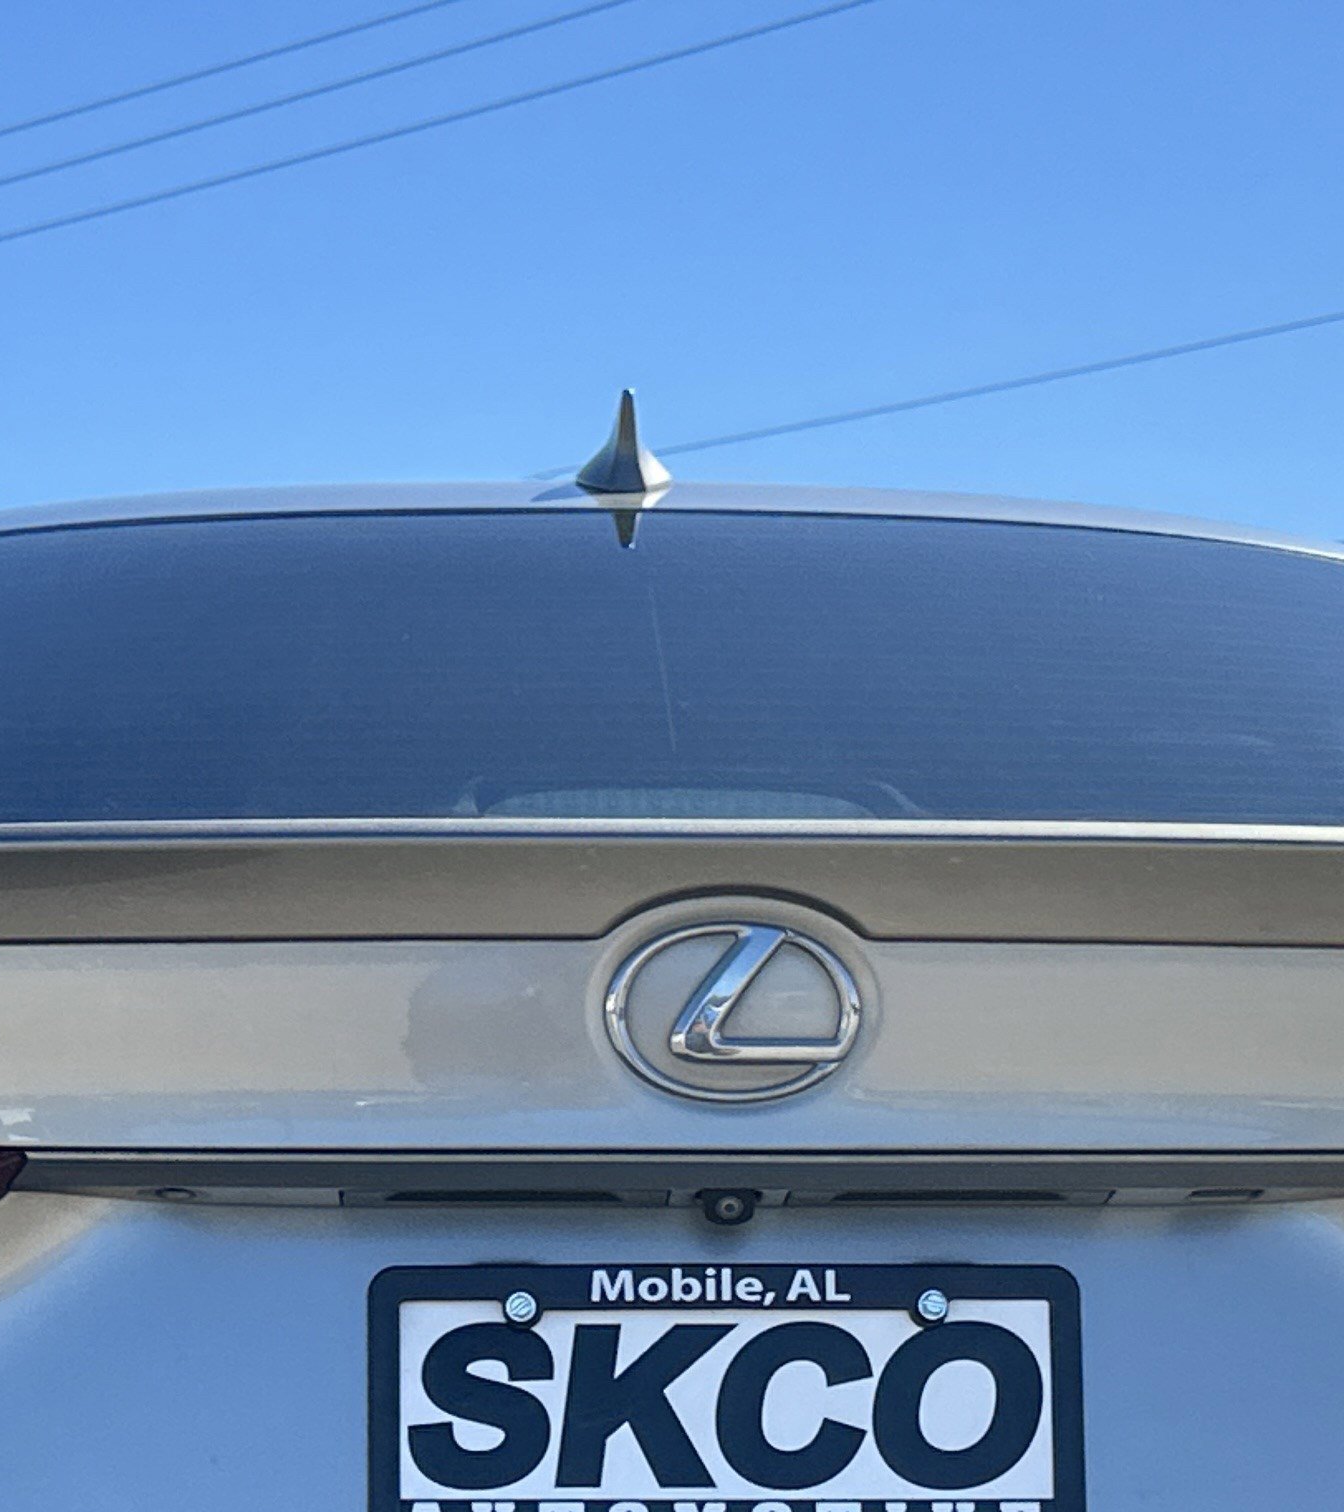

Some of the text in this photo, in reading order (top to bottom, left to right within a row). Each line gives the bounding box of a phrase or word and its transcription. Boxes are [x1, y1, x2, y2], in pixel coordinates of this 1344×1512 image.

[590, 1269, 852, 1306] Mobile, AL
[407, 1320, 1043, 1491] SKCO
